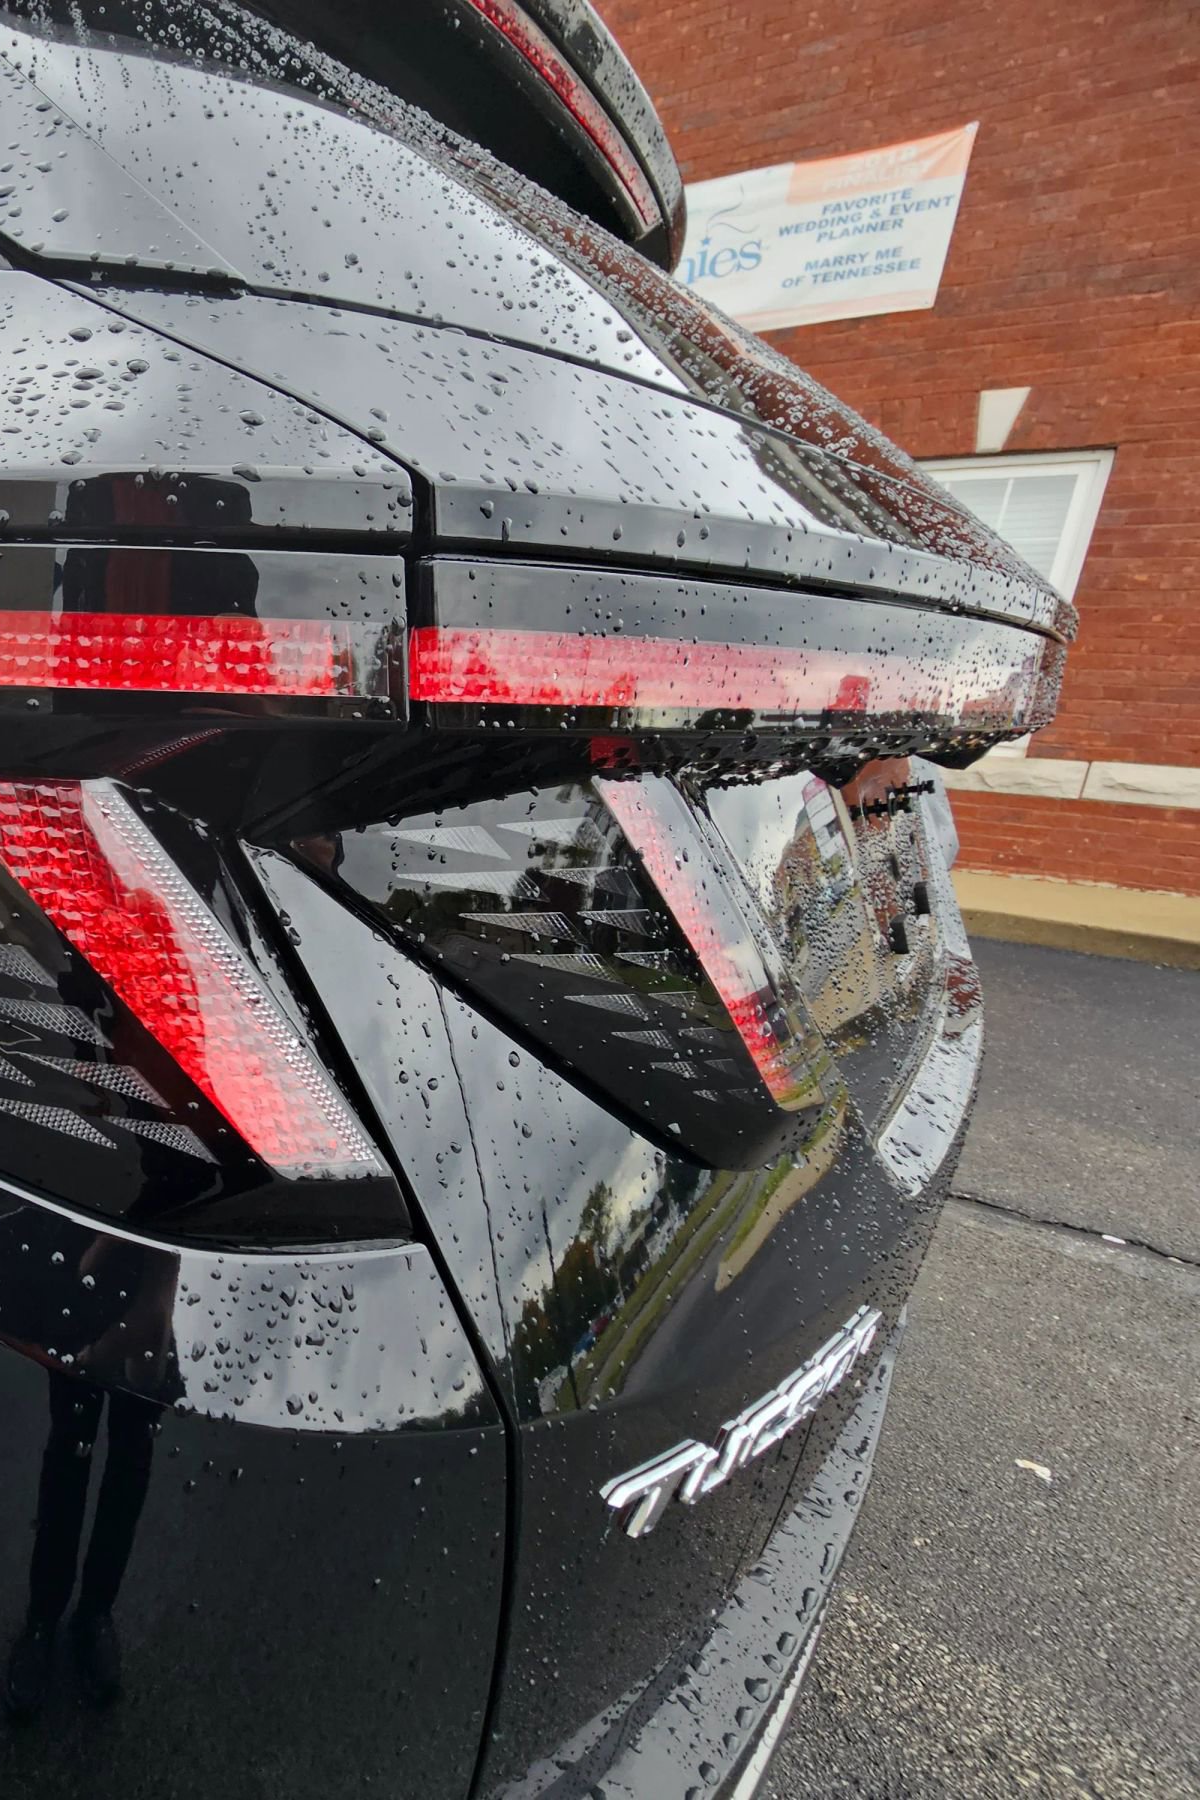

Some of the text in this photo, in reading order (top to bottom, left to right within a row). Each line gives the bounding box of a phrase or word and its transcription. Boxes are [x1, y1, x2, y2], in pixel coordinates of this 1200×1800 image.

[777, 194, 956, 238] WEDDING & EVENT
[821, 187, 914, 216] FAVORITE
[816, 218, 905, 243] PLANNER
[781, 257, 922, 289] OF TENNESSEE
[804, 246, 904, 272] MARRY ME
